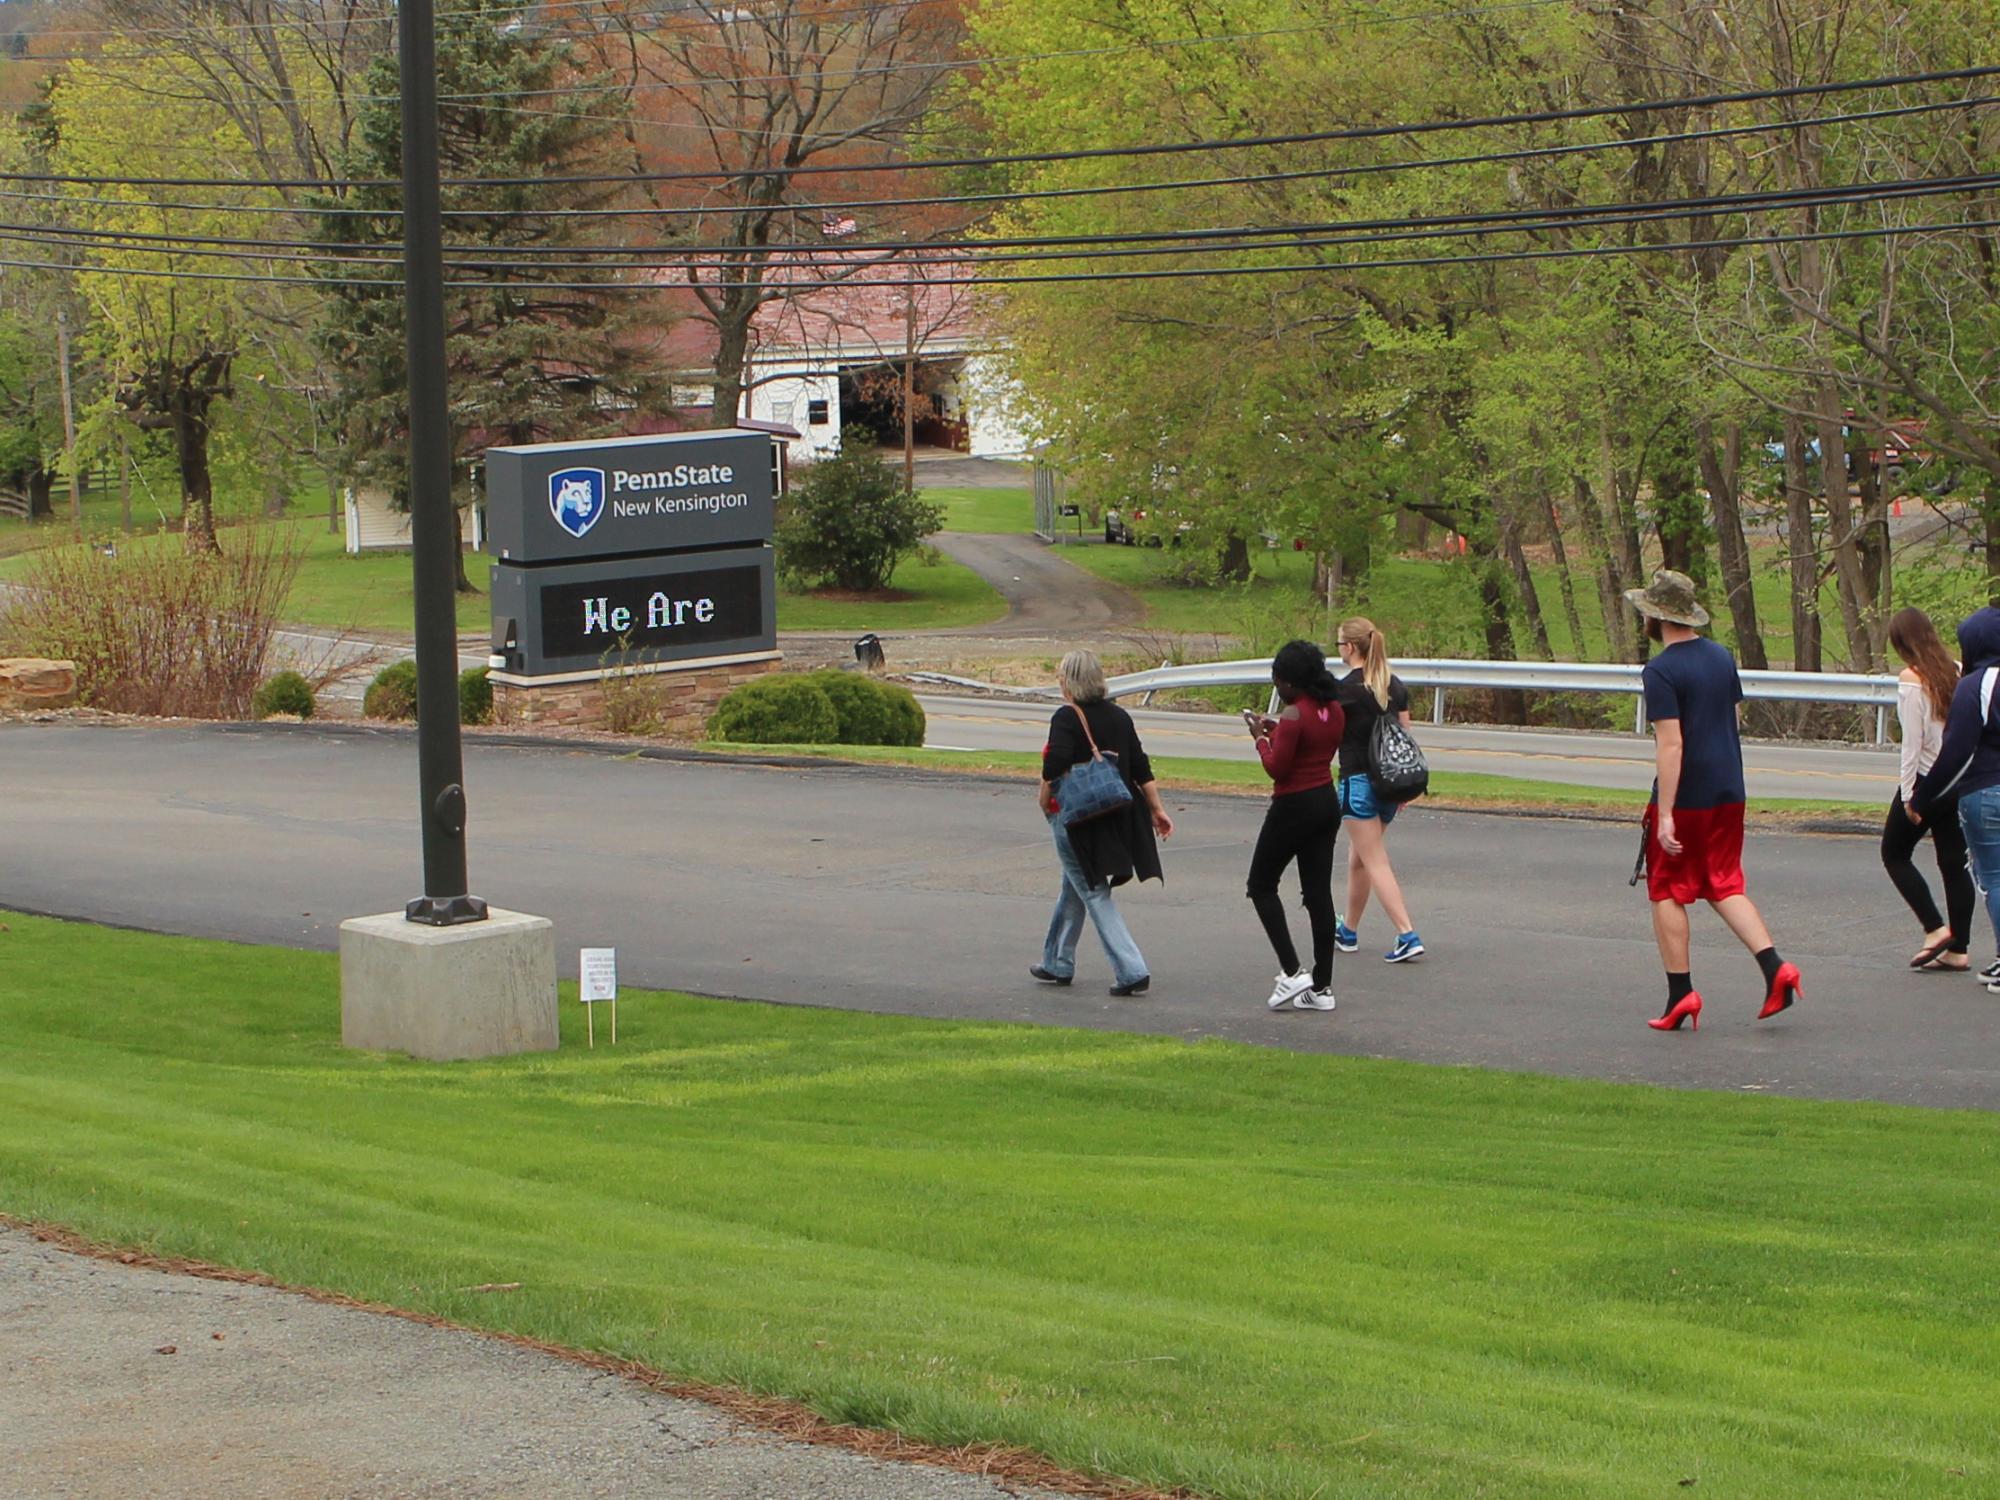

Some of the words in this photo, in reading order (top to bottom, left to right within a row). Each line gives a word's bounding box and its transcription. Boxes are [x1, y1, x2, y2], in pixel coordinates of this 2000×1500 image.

[612, 464, 734, 492] PennState
[613, 500, 651, 518] New
[655, 493, 748, 514] Kensington
[582, 597, 631, 635] We
[647, 591, 715, 628] Are
